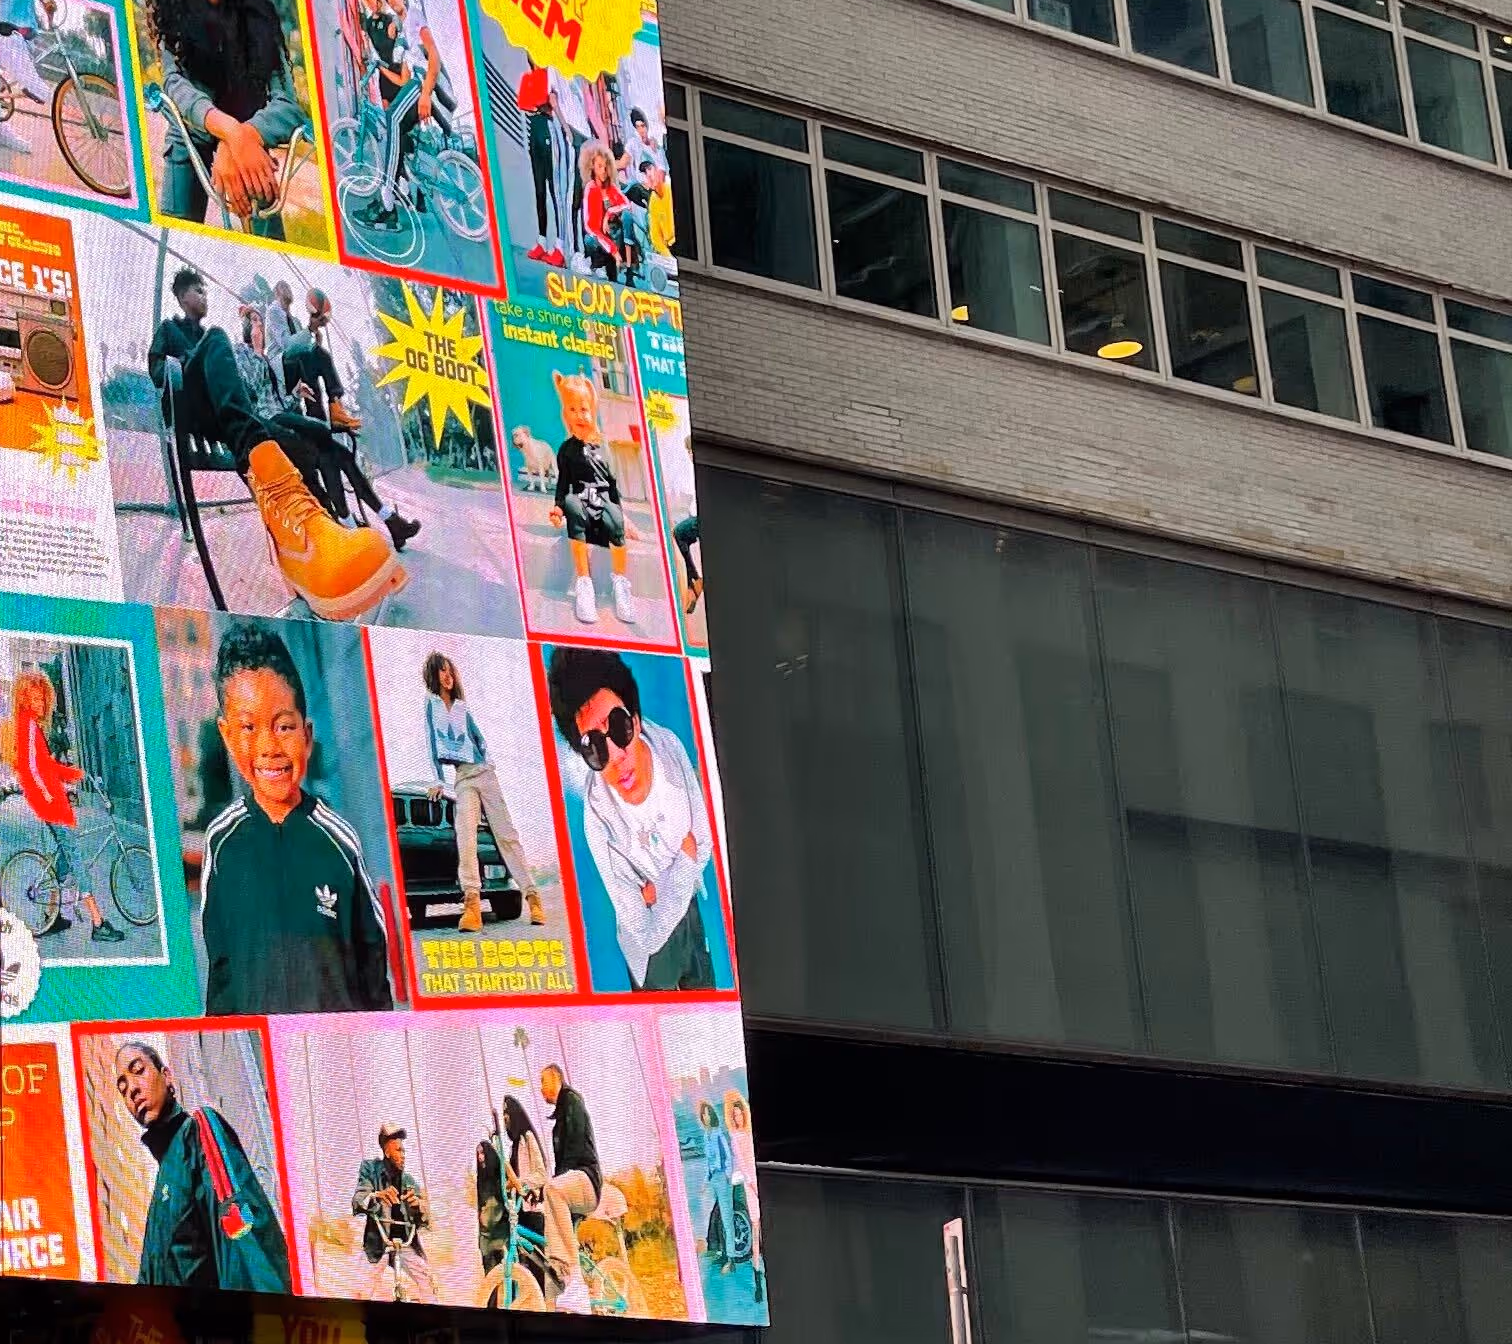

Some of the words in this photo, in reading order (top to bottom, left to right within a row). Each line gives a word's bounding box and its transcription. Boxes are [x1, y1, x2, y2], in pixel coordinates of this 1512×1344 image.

[546, 271, 616, 318] SHOW
[620, 288, 664, 326] OFF
[493, 300, 523, 318] take
[526, 306, 534, 321] a
[538, 310, 573, 328] shine
[577, 316, 590, 332] to
[593, 320, 617, 338] this
[424, 331, 457, 359] THE
[502, 318, 559, 349] instant
[562, 332, 616, 361] classic
[405, 347, 428, 373] OG
[434, 355, 478, 386] BOOT
[422, 940, 477, 968] THE
[480, 940, 565, 968] BOOTS
[422, 973, 459, 992] THAT
[463, 972, 526, 992] STARTED
[530, 972, 541, 991] IT
[546, 970, 573, 992] ALL
[2, 1063, 48, 1095] OF
